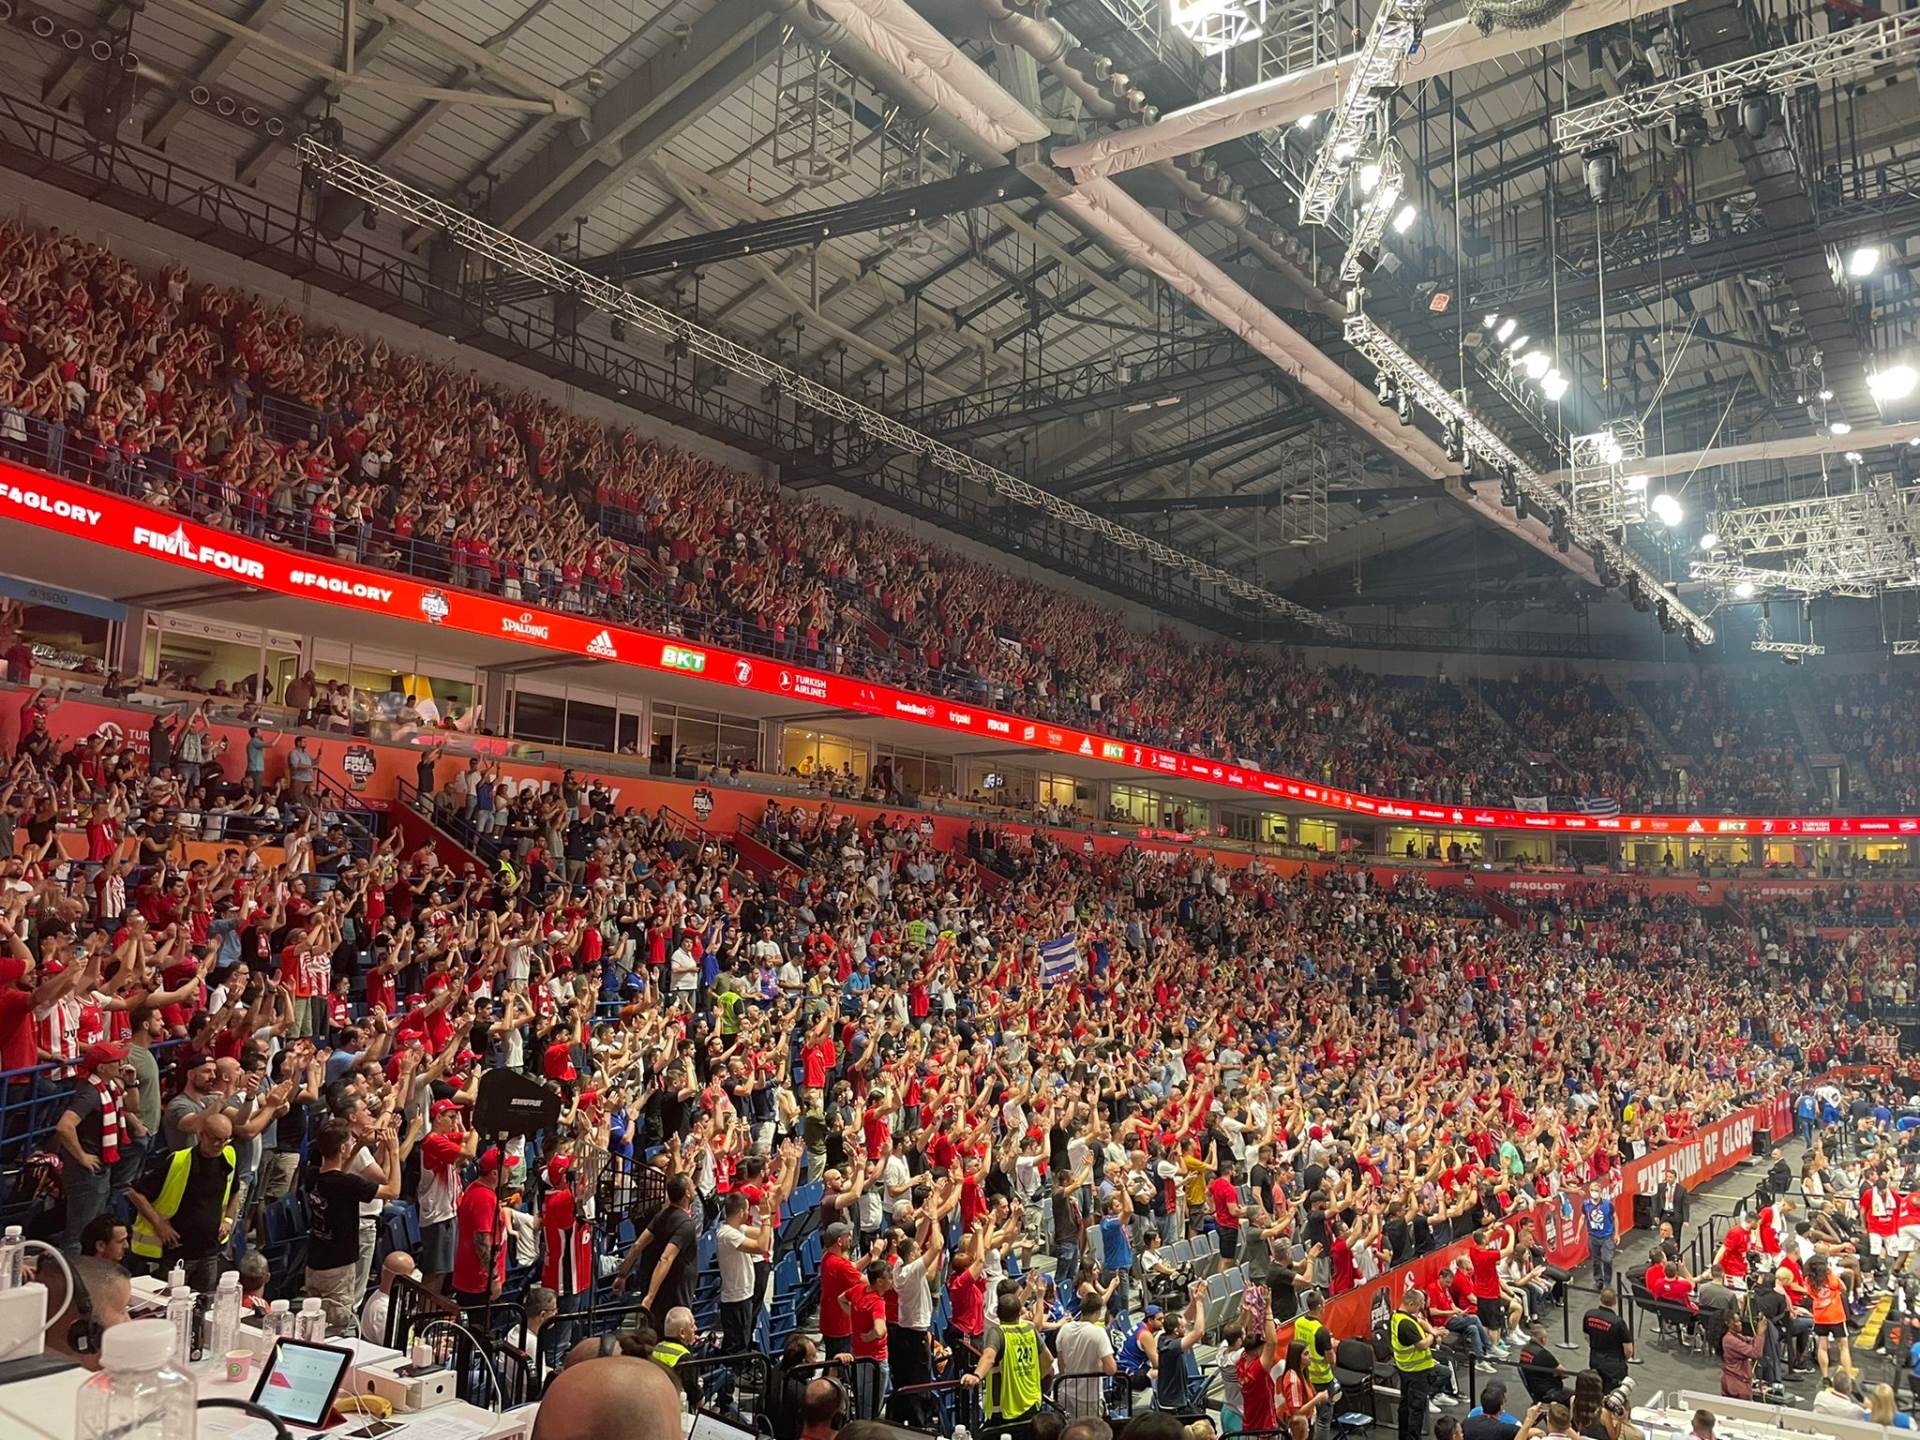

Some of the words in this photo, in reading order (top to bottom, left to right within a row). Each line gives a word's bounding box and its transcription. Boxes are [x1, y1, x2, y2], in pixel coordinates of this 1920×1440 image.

[133, 521, 198, 561] FINAL
[199, 545, 265, 580] FOUR
[289, 570, 393, 603] #F4GLORY
[502, 617, 549, 640] SPALDING
[586, 644, 618, 658] adidas
[661, 646, 705, 671] BKT
[794, 685, 827, 699] AIRLINES
[795, 674, 827, 689] TURKISH
[1103, 743, 1124, 759] BKT
[1637, 1158, 1666, 1195] THE
[1669, 1142, 1702, 1184] HOME
[1703, 1131, 1719, 1166] OF
[1722, 1115, 1755, 1157] GLORY
